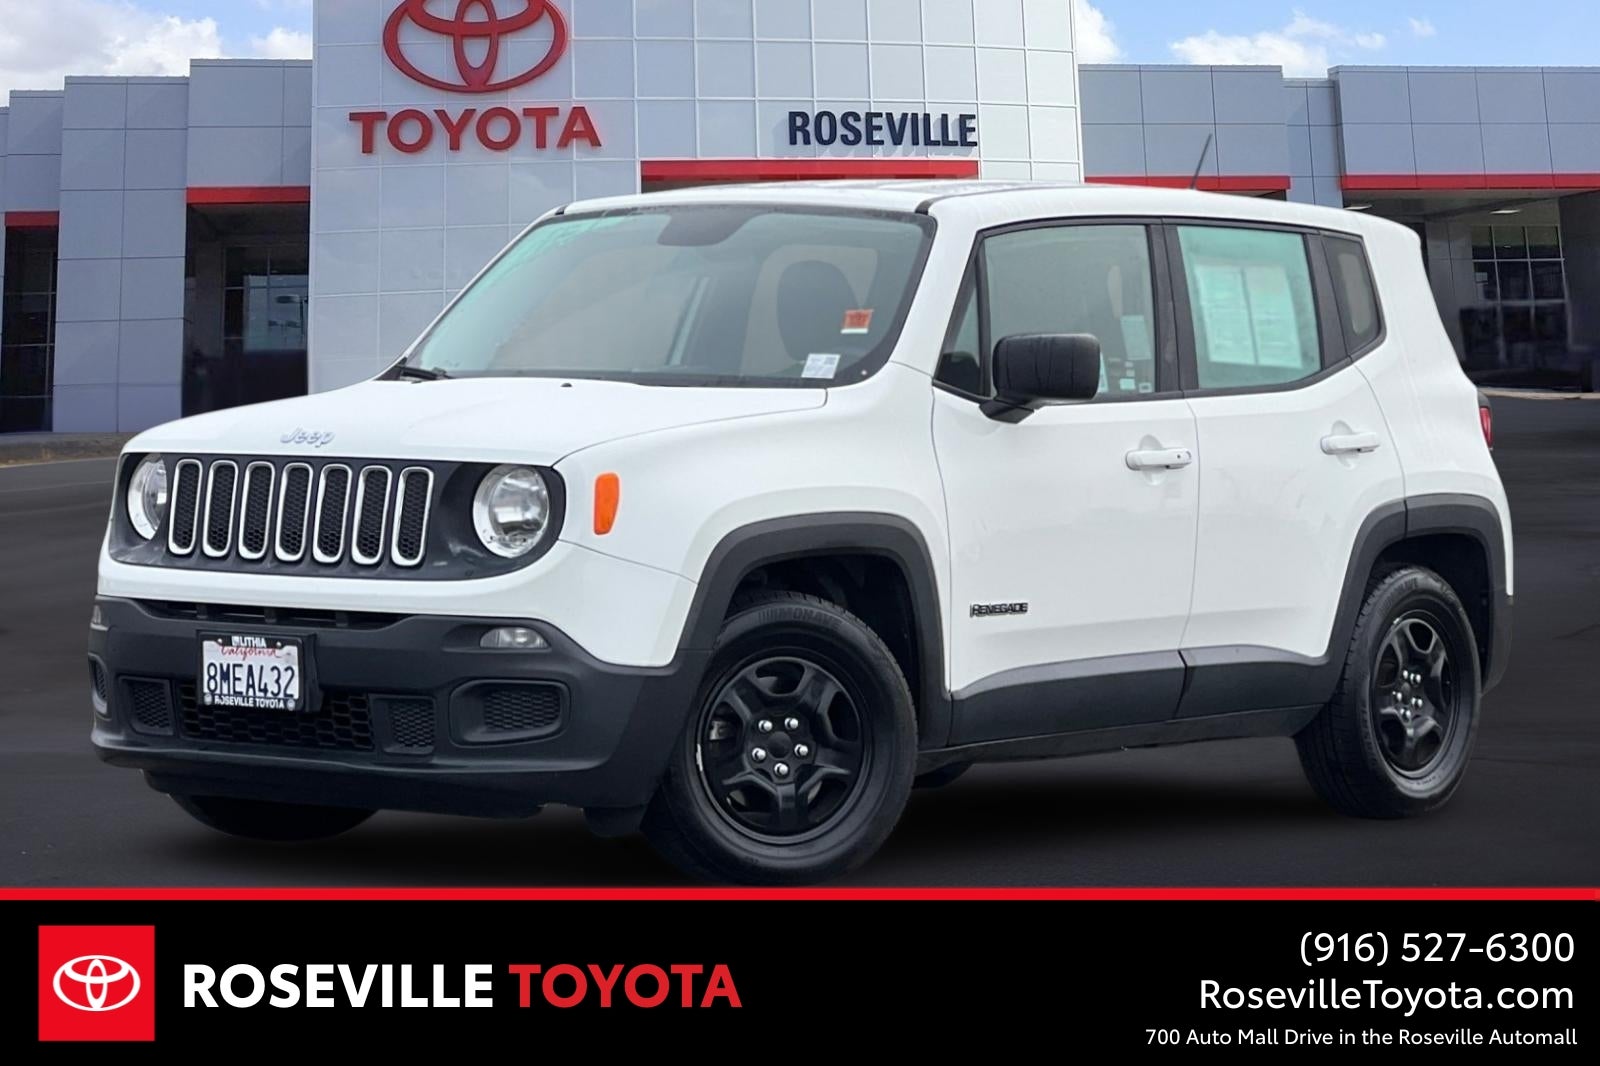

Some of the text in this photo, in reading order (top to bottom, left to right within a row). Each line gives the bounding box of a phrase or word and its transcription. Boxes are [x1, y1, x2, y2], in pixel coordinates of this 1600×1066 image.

[349, 106, 602, 154] TOYOTA
[788, 111, 978, 147] ROSEVILLE
[280, 426, 336, 448] Jeep
[970, 602, 1029, 618] RENEGADE
[239, 636, 267, 648] LITHIA
[221, 645, 281, 661] California
[207, 662, 295, 698] 8MEA432
[214, 695, 285, 709] ROSEVILLE TOYOTA
